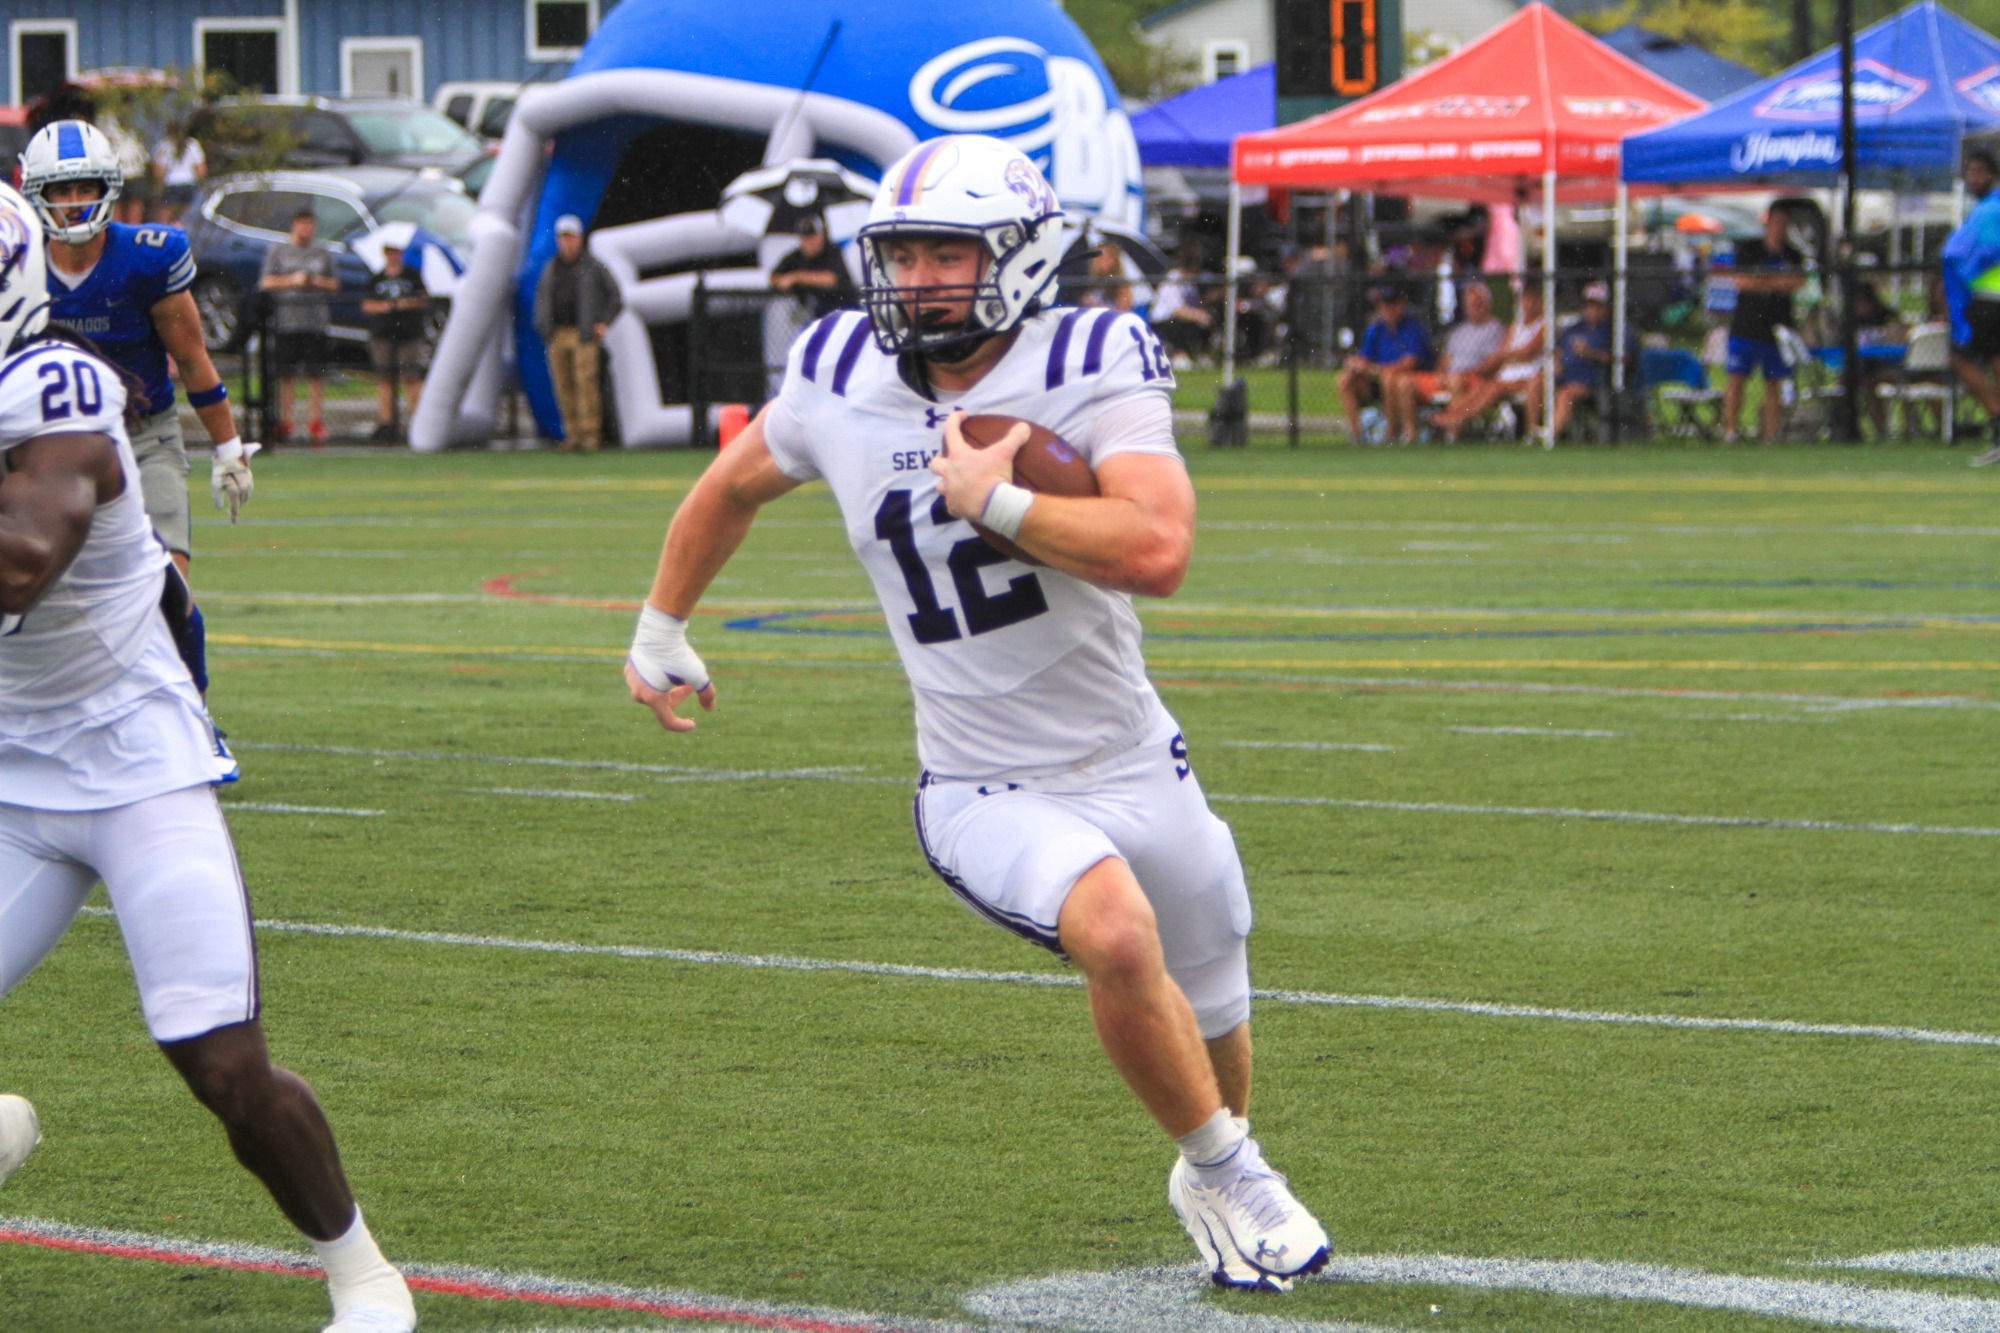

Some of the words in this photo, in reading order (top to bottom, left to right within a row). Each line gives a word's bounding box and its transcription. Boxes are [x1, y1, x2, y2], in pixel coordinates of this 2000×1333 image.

[1330, 0, 1376, 96] 0
[135, 228, 168, 248] 2
[1128, 325, 1174, 382] 12
[38, 360, 103, 422] 20
[874, 488, 1050, 645] 12
